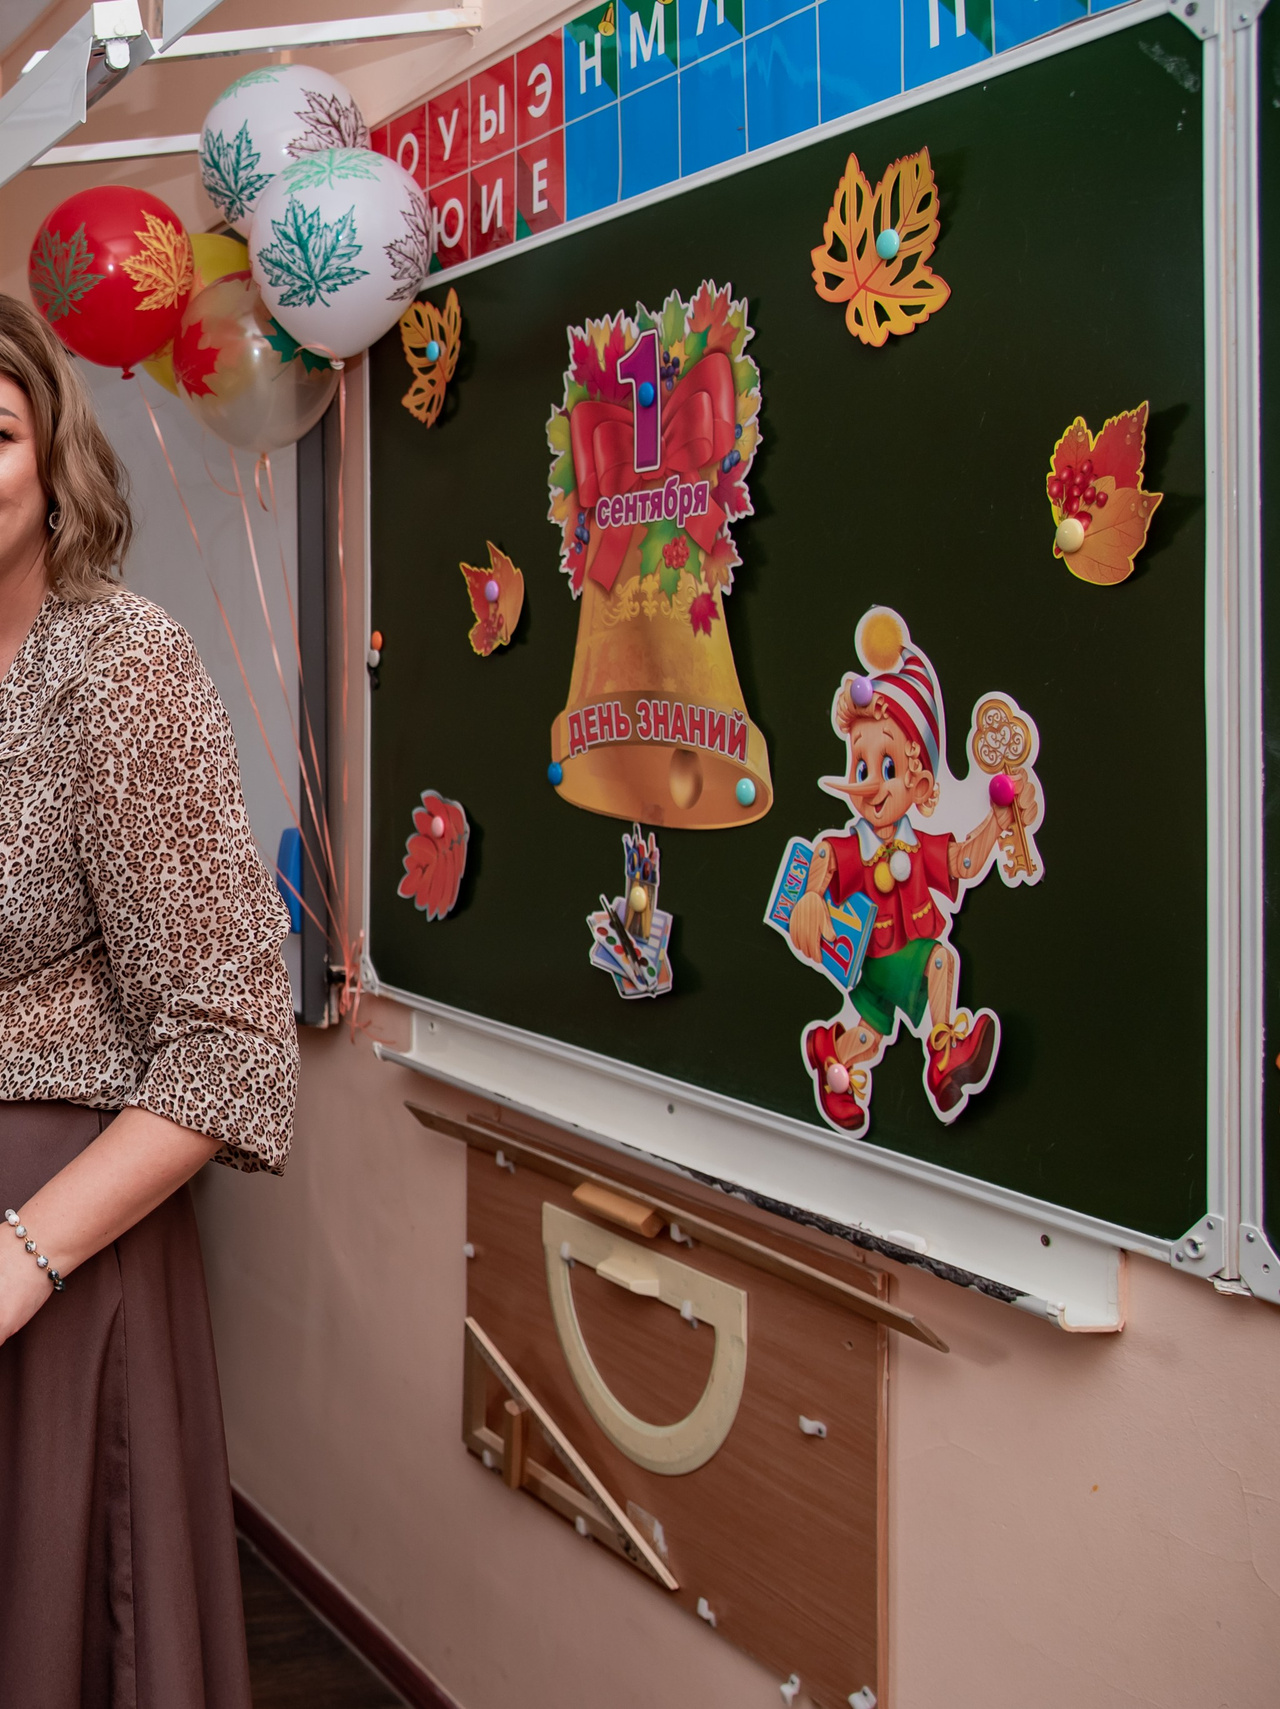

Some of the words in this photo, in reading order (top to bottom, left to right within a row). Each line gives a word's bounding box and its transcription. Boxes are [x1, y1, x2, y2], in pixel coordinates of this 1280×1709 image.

[437, 108, 459, 162] У
[479, 84, 506, 144] Ы
[526, 62, 553, 118] Э
[579, 31, 602, 95] Н
[629, 1, 665, 70] М
[432, 198, 464, 254] Ю
[481, 177, 503, 235] И
[532, 158, 549, 215] Е
[617, 328, 662, 473] 1
[596, 474, 710, 530] сентября
[567, 700, 633, 759] ДЕНЬ
[635, 698, 749, 764] ЗНАНИЙ
[773, 848, 810, 923] АЗБУКА
